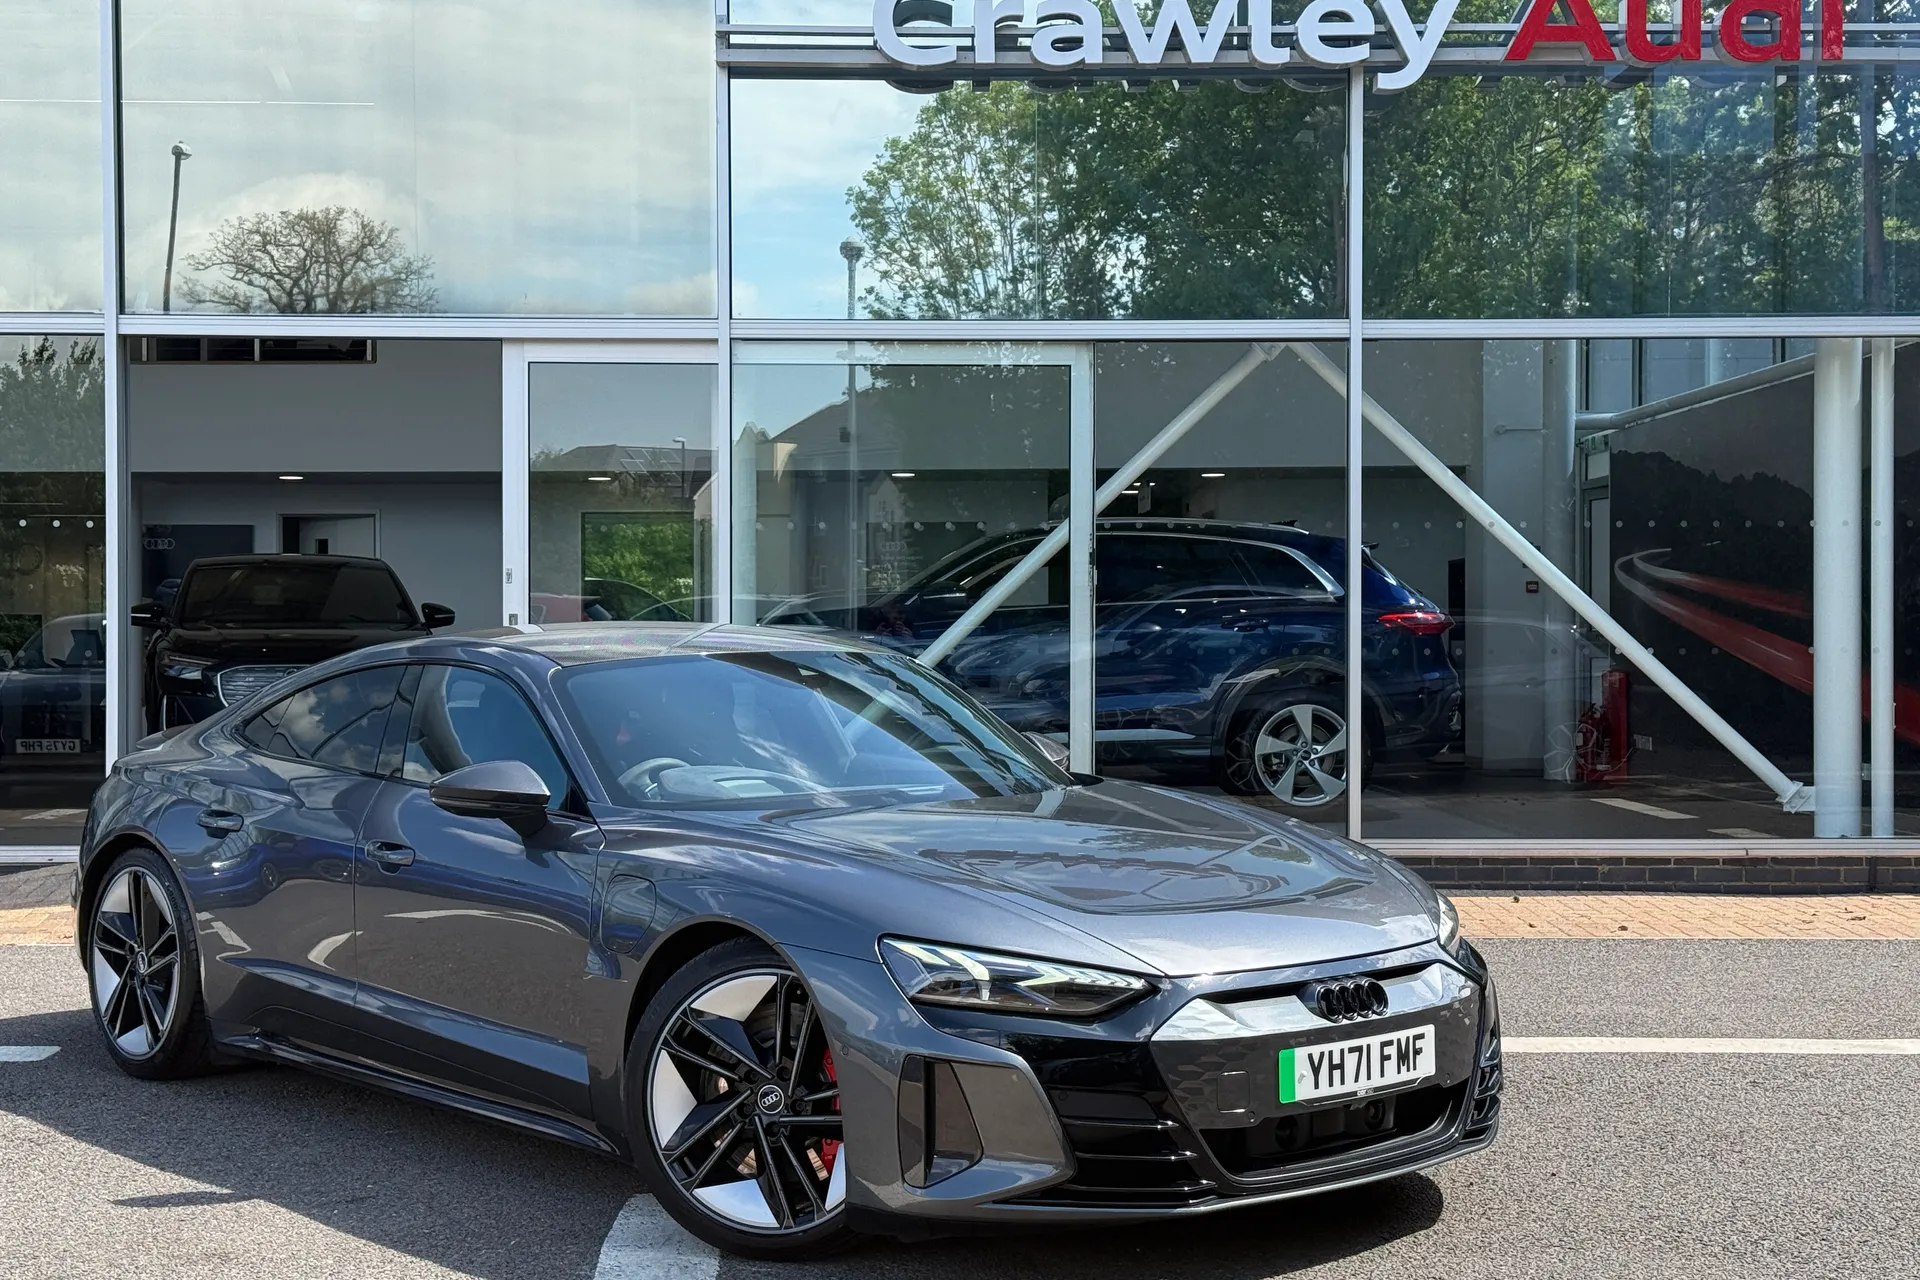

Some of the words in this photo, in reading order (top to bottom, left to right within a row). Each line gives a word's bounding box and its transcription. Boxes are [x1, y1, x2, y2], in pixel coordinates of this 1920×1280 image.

[873, 0, 1459, 95] Crawley
[1307, 1043, 1372, 1090] YH71
[1379, 1032, 1426, 1079] FMF
